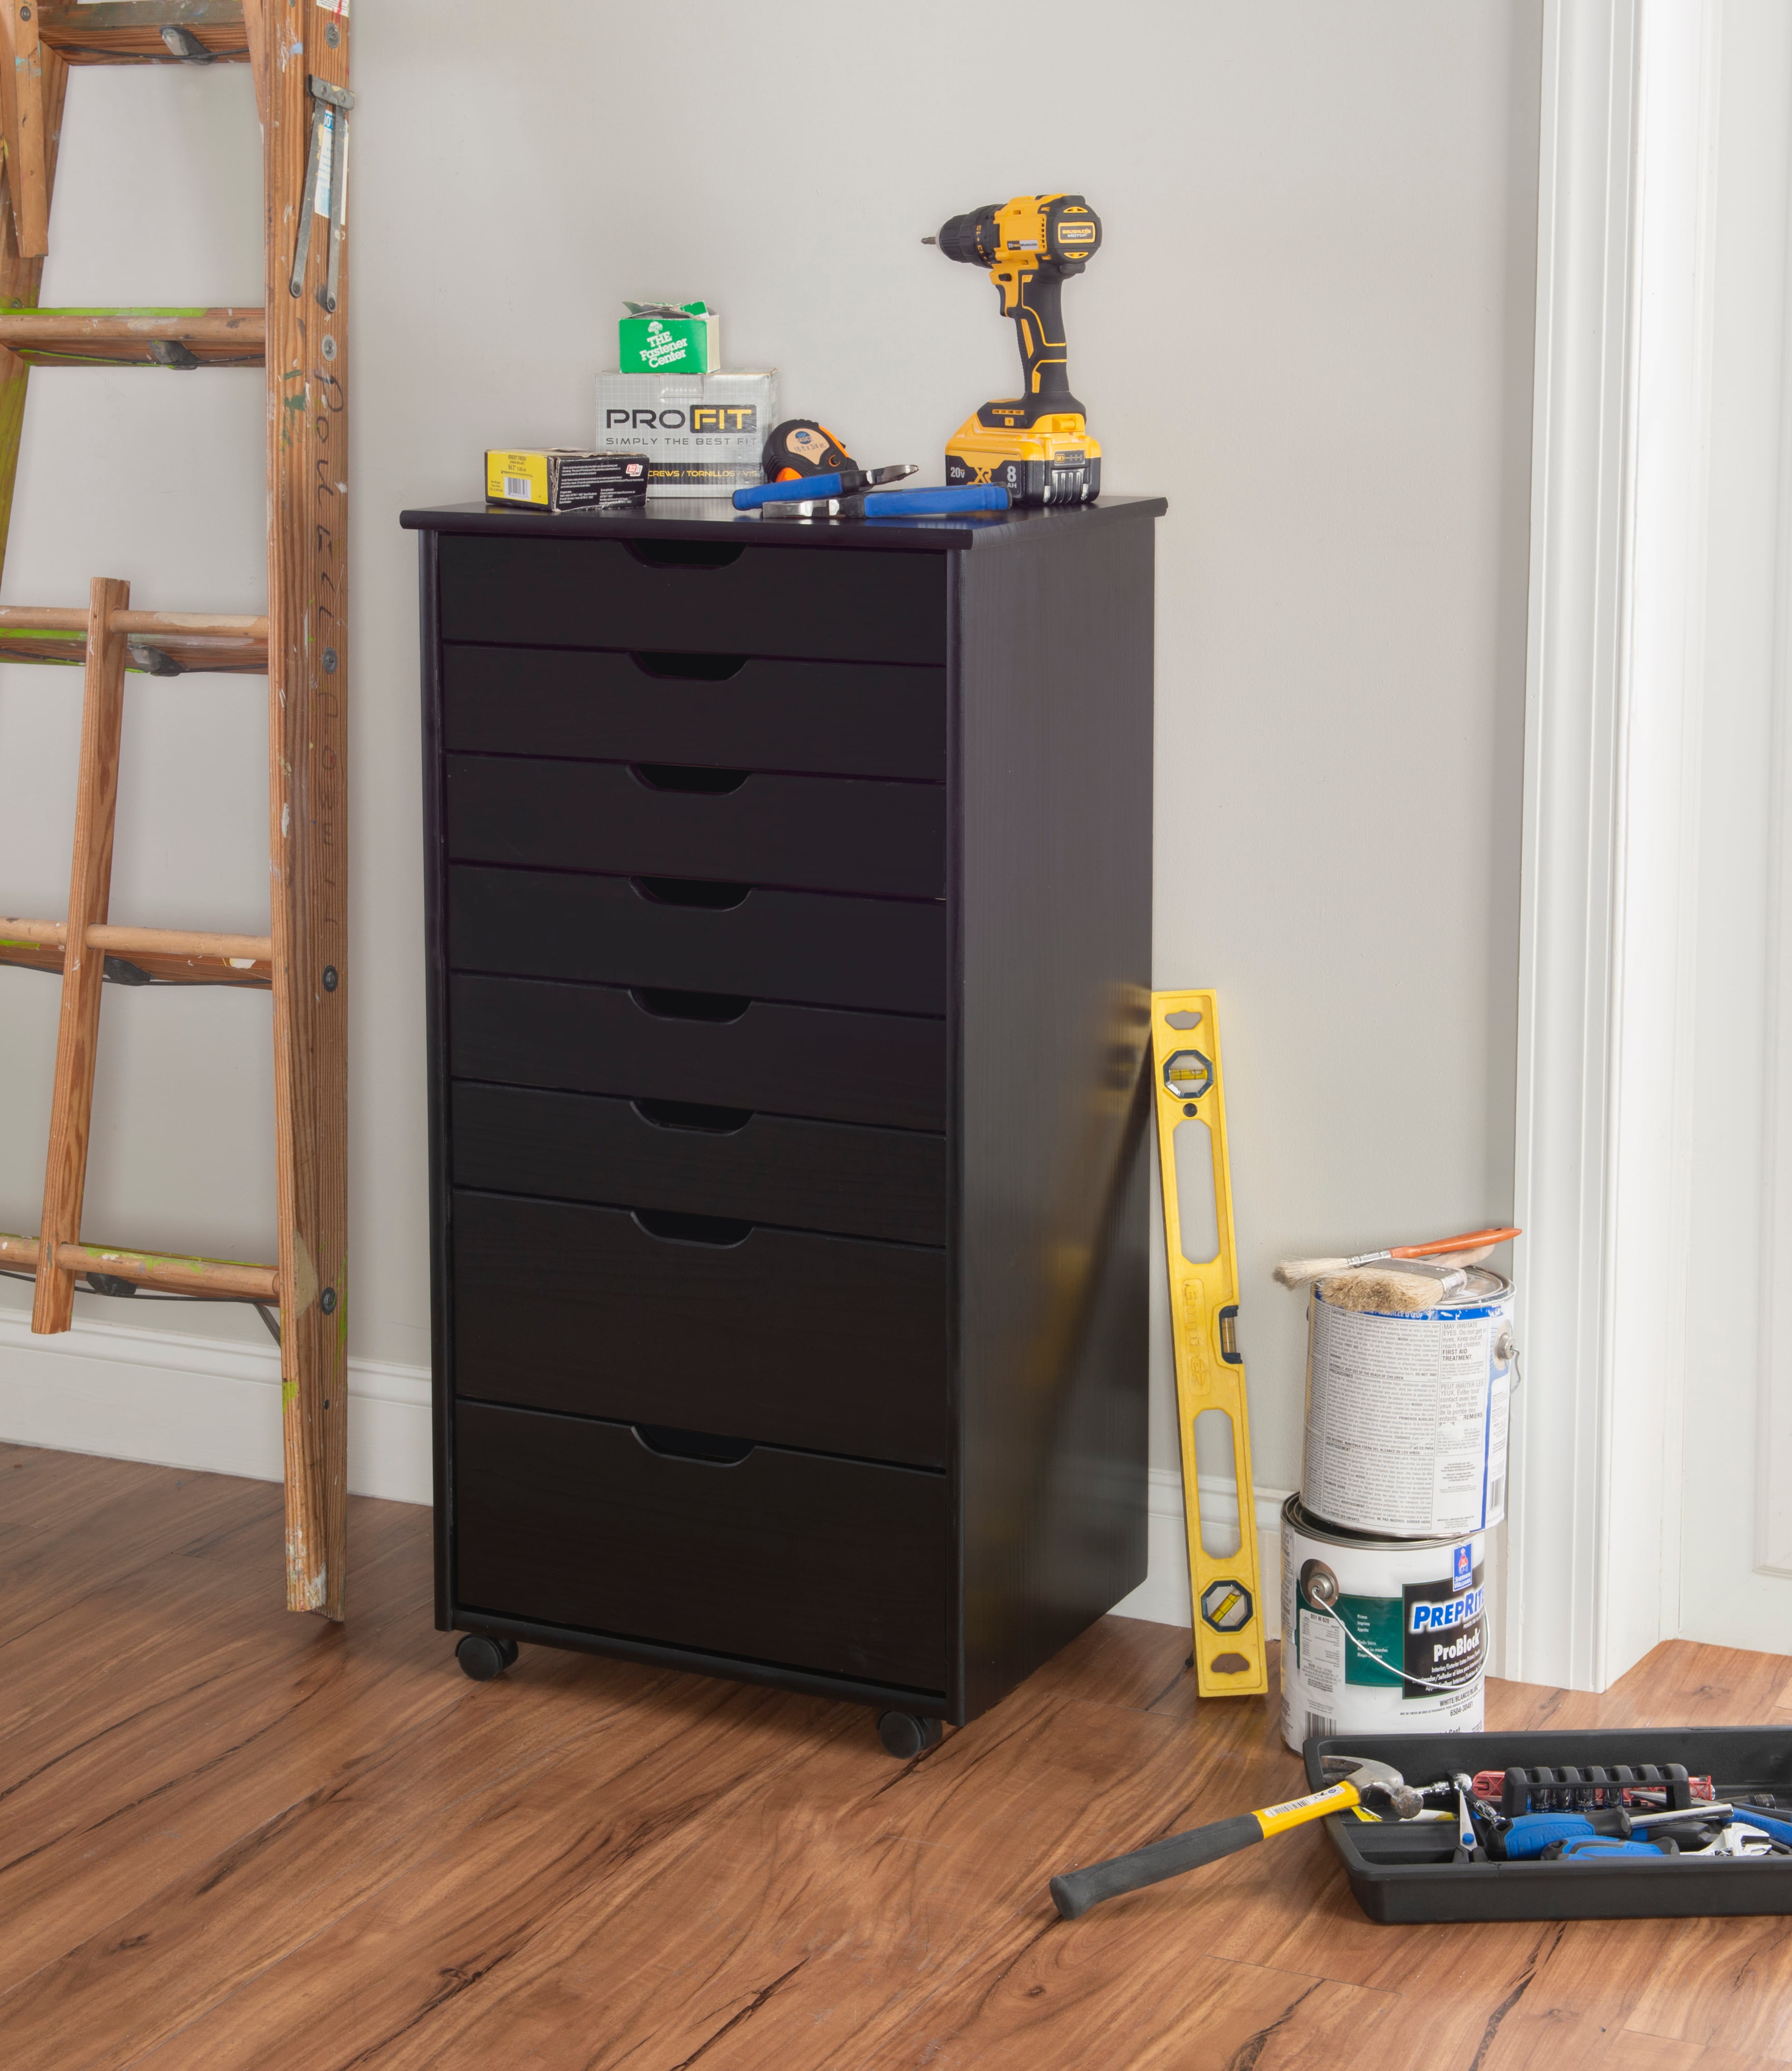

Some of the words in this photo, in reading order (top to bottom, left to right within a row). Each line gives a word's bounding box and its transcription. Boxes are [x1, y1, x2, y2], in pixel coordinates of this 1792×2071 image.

[647, 331, 672, 347] THE
[639, 338, 687, 361] Fastener
[649, 349, 686, 368] Center
[974, 467, 992, 484] XR
[1007, 465, 1017, 482] 8
[1454, 1578, 1471, 1589] WILLIAMS
[1455, 1572, 1471, 1583] SHERWIN
